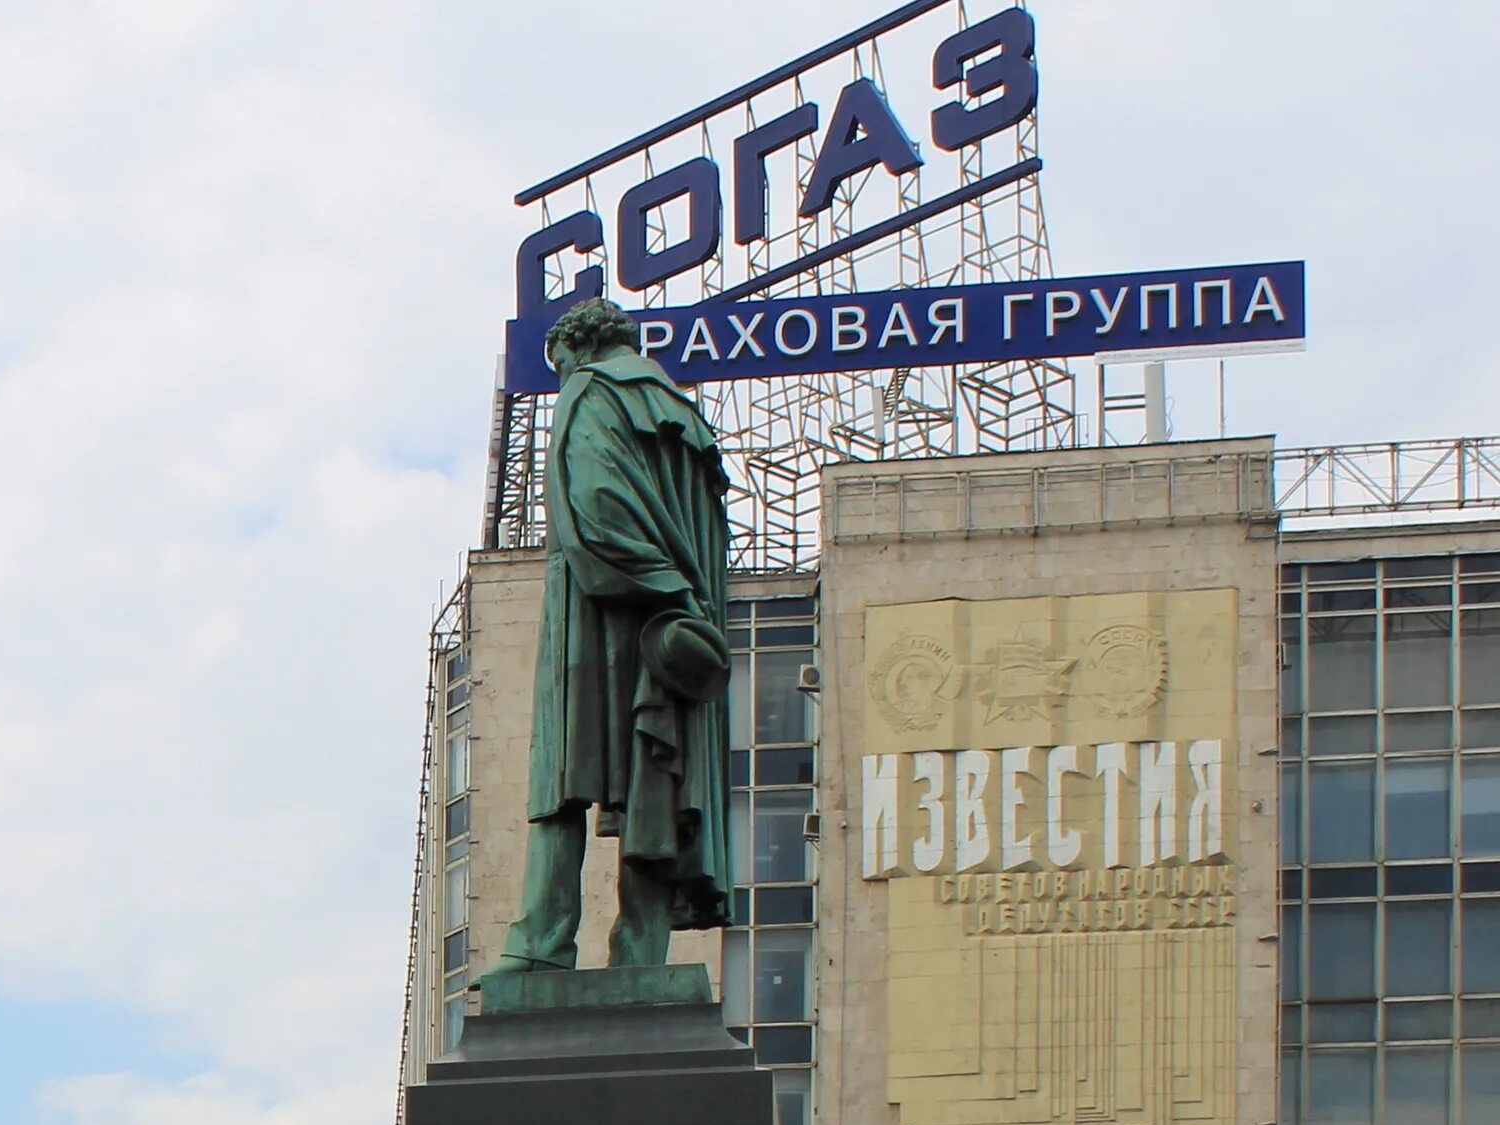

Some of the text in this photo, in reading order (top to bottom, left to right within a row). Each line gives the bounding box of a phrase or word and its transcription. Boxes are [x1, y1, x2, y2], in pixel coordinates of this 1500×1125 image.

[516, 7, 1038, 320] СОГАЗ
[544, 276, 1286, 373] РАХОВАЯ ГРУППА
[862, 739, 1226, 881] ИЗВЕСТИЯ
[940, 863, 1236, 904] СОВЕТОВ НАРОДНЫХ
[976, 895, 1236, 934] ДЕПУТАТОВ СССР
